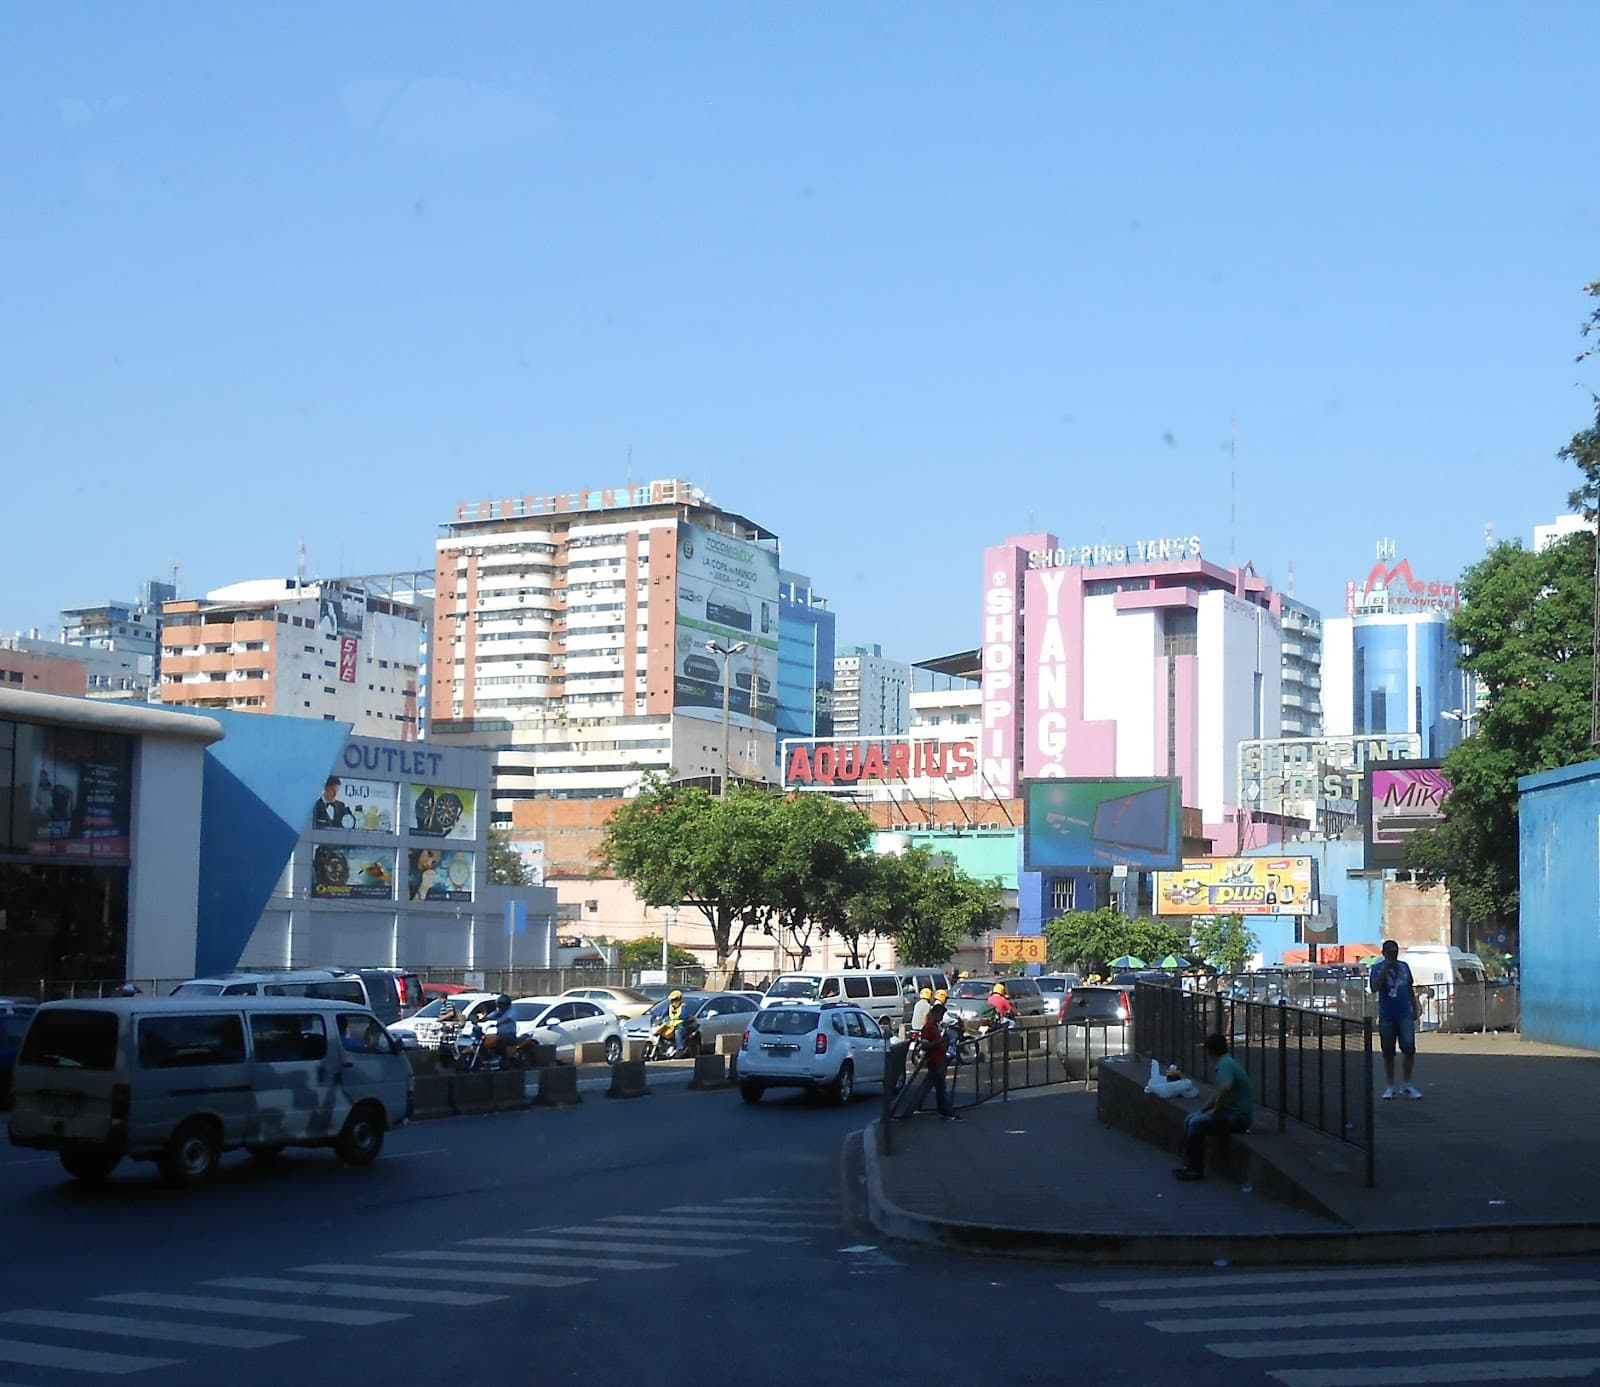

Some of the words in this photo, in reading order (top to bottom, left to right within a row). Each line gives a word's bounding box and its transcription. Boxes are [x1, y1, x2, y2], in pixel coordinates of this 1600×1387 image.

[342, 744, 443, 777] OUTLET
[788, 742, 974, 786] AQUARIUS
[1245, 740, 1412, 774] SHOPPING
